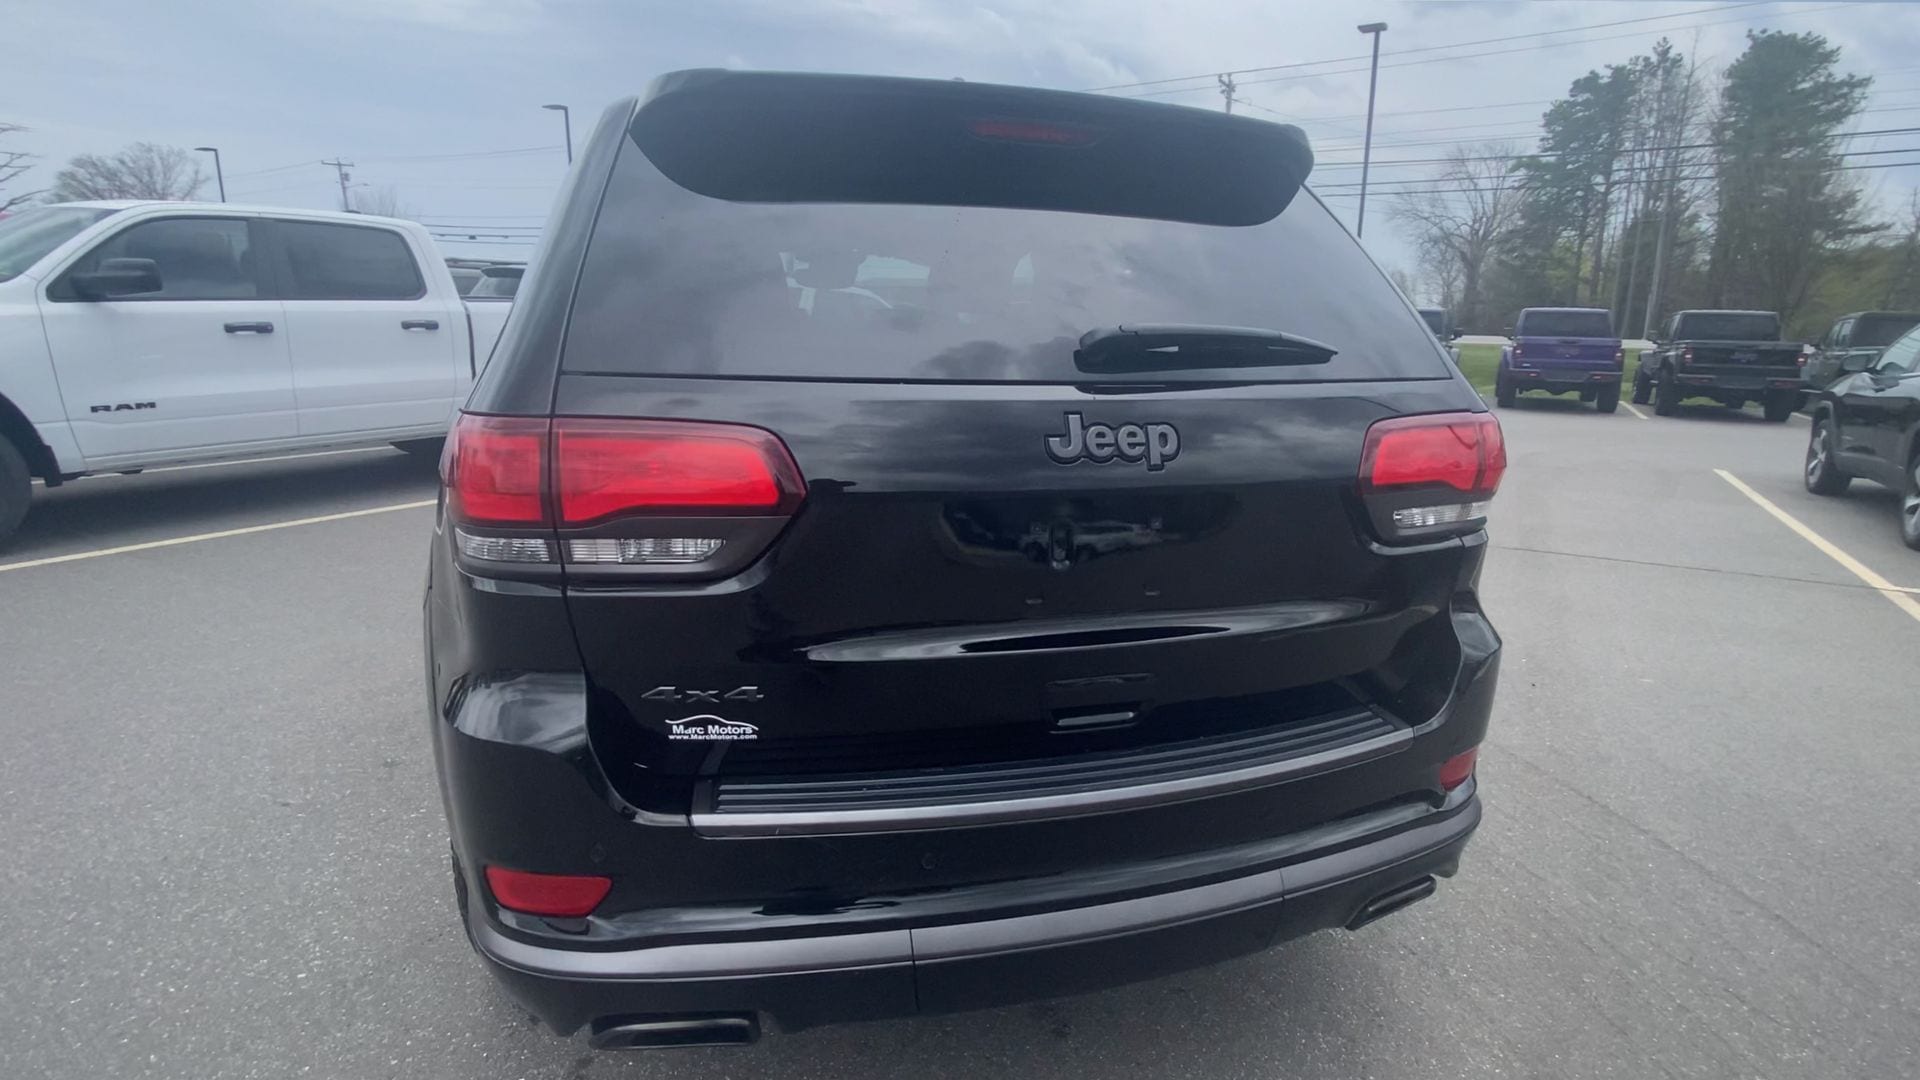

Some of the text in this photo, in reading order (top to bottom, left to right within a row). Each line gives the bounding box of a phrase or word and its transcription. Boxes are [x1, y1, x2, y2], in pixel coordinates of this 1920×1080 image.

[90, 402, 157, 413] RAM
[1045, 411, 1181, 472] Jeep
[641, 686, 765, 703] 4x4
[672, 725, 753, 735] Marc Motors
